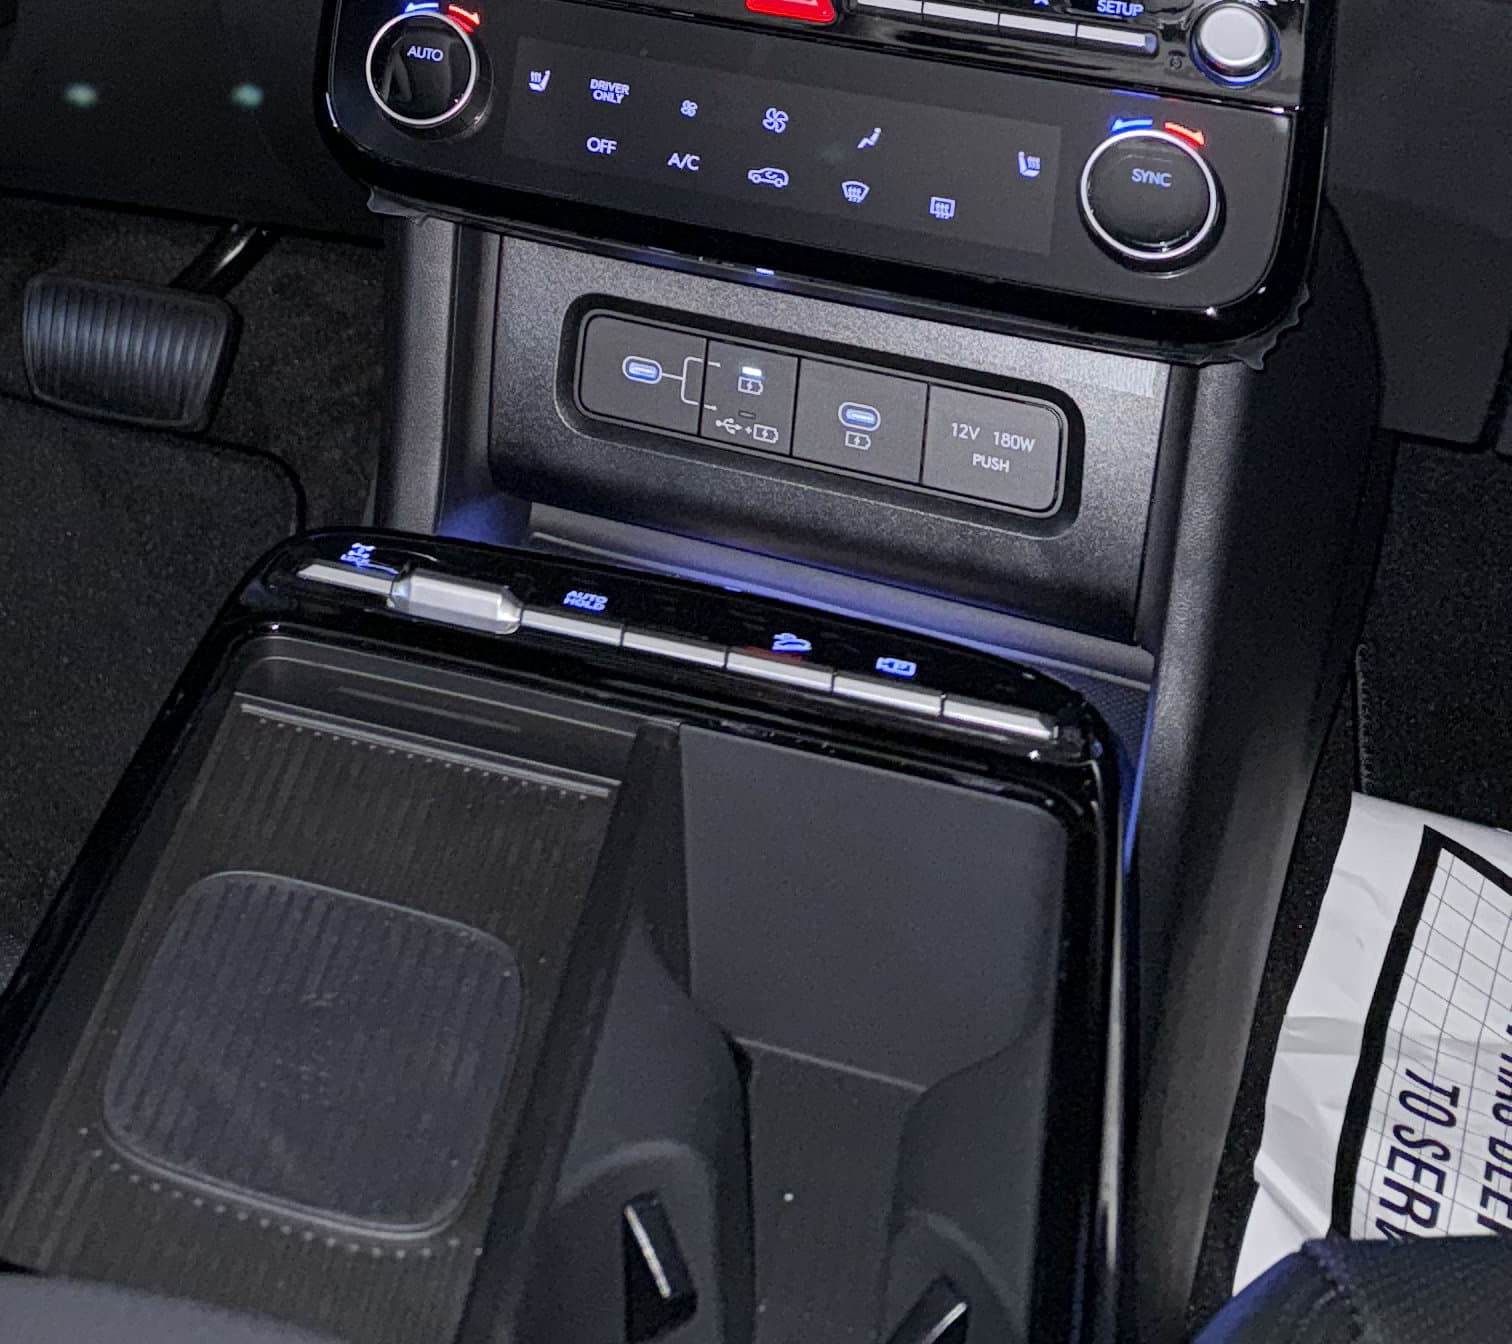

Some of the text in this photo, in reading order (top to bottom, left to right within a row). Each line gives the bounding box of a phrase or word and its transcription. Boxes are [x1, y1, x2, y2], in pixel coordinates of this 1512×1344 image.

[407, 45, 444, 62] AUTO
[589, 78, 630, 96] DRIVER
[592, 90, 624, 105] ONLY
[586, 136, 617, 155] OFF
[667, 152, 700, 172] A/C
[1131, 167, 1173, 188] SYNC
[951, 422, 1037, 453] 12V 180W
[972, 453, 1010, 473] PUSH
[563, 597, 606, 611] HOLD
[567, 590, 609, 604] AUTO
[1399, 1068, 1461, 1127] TO
